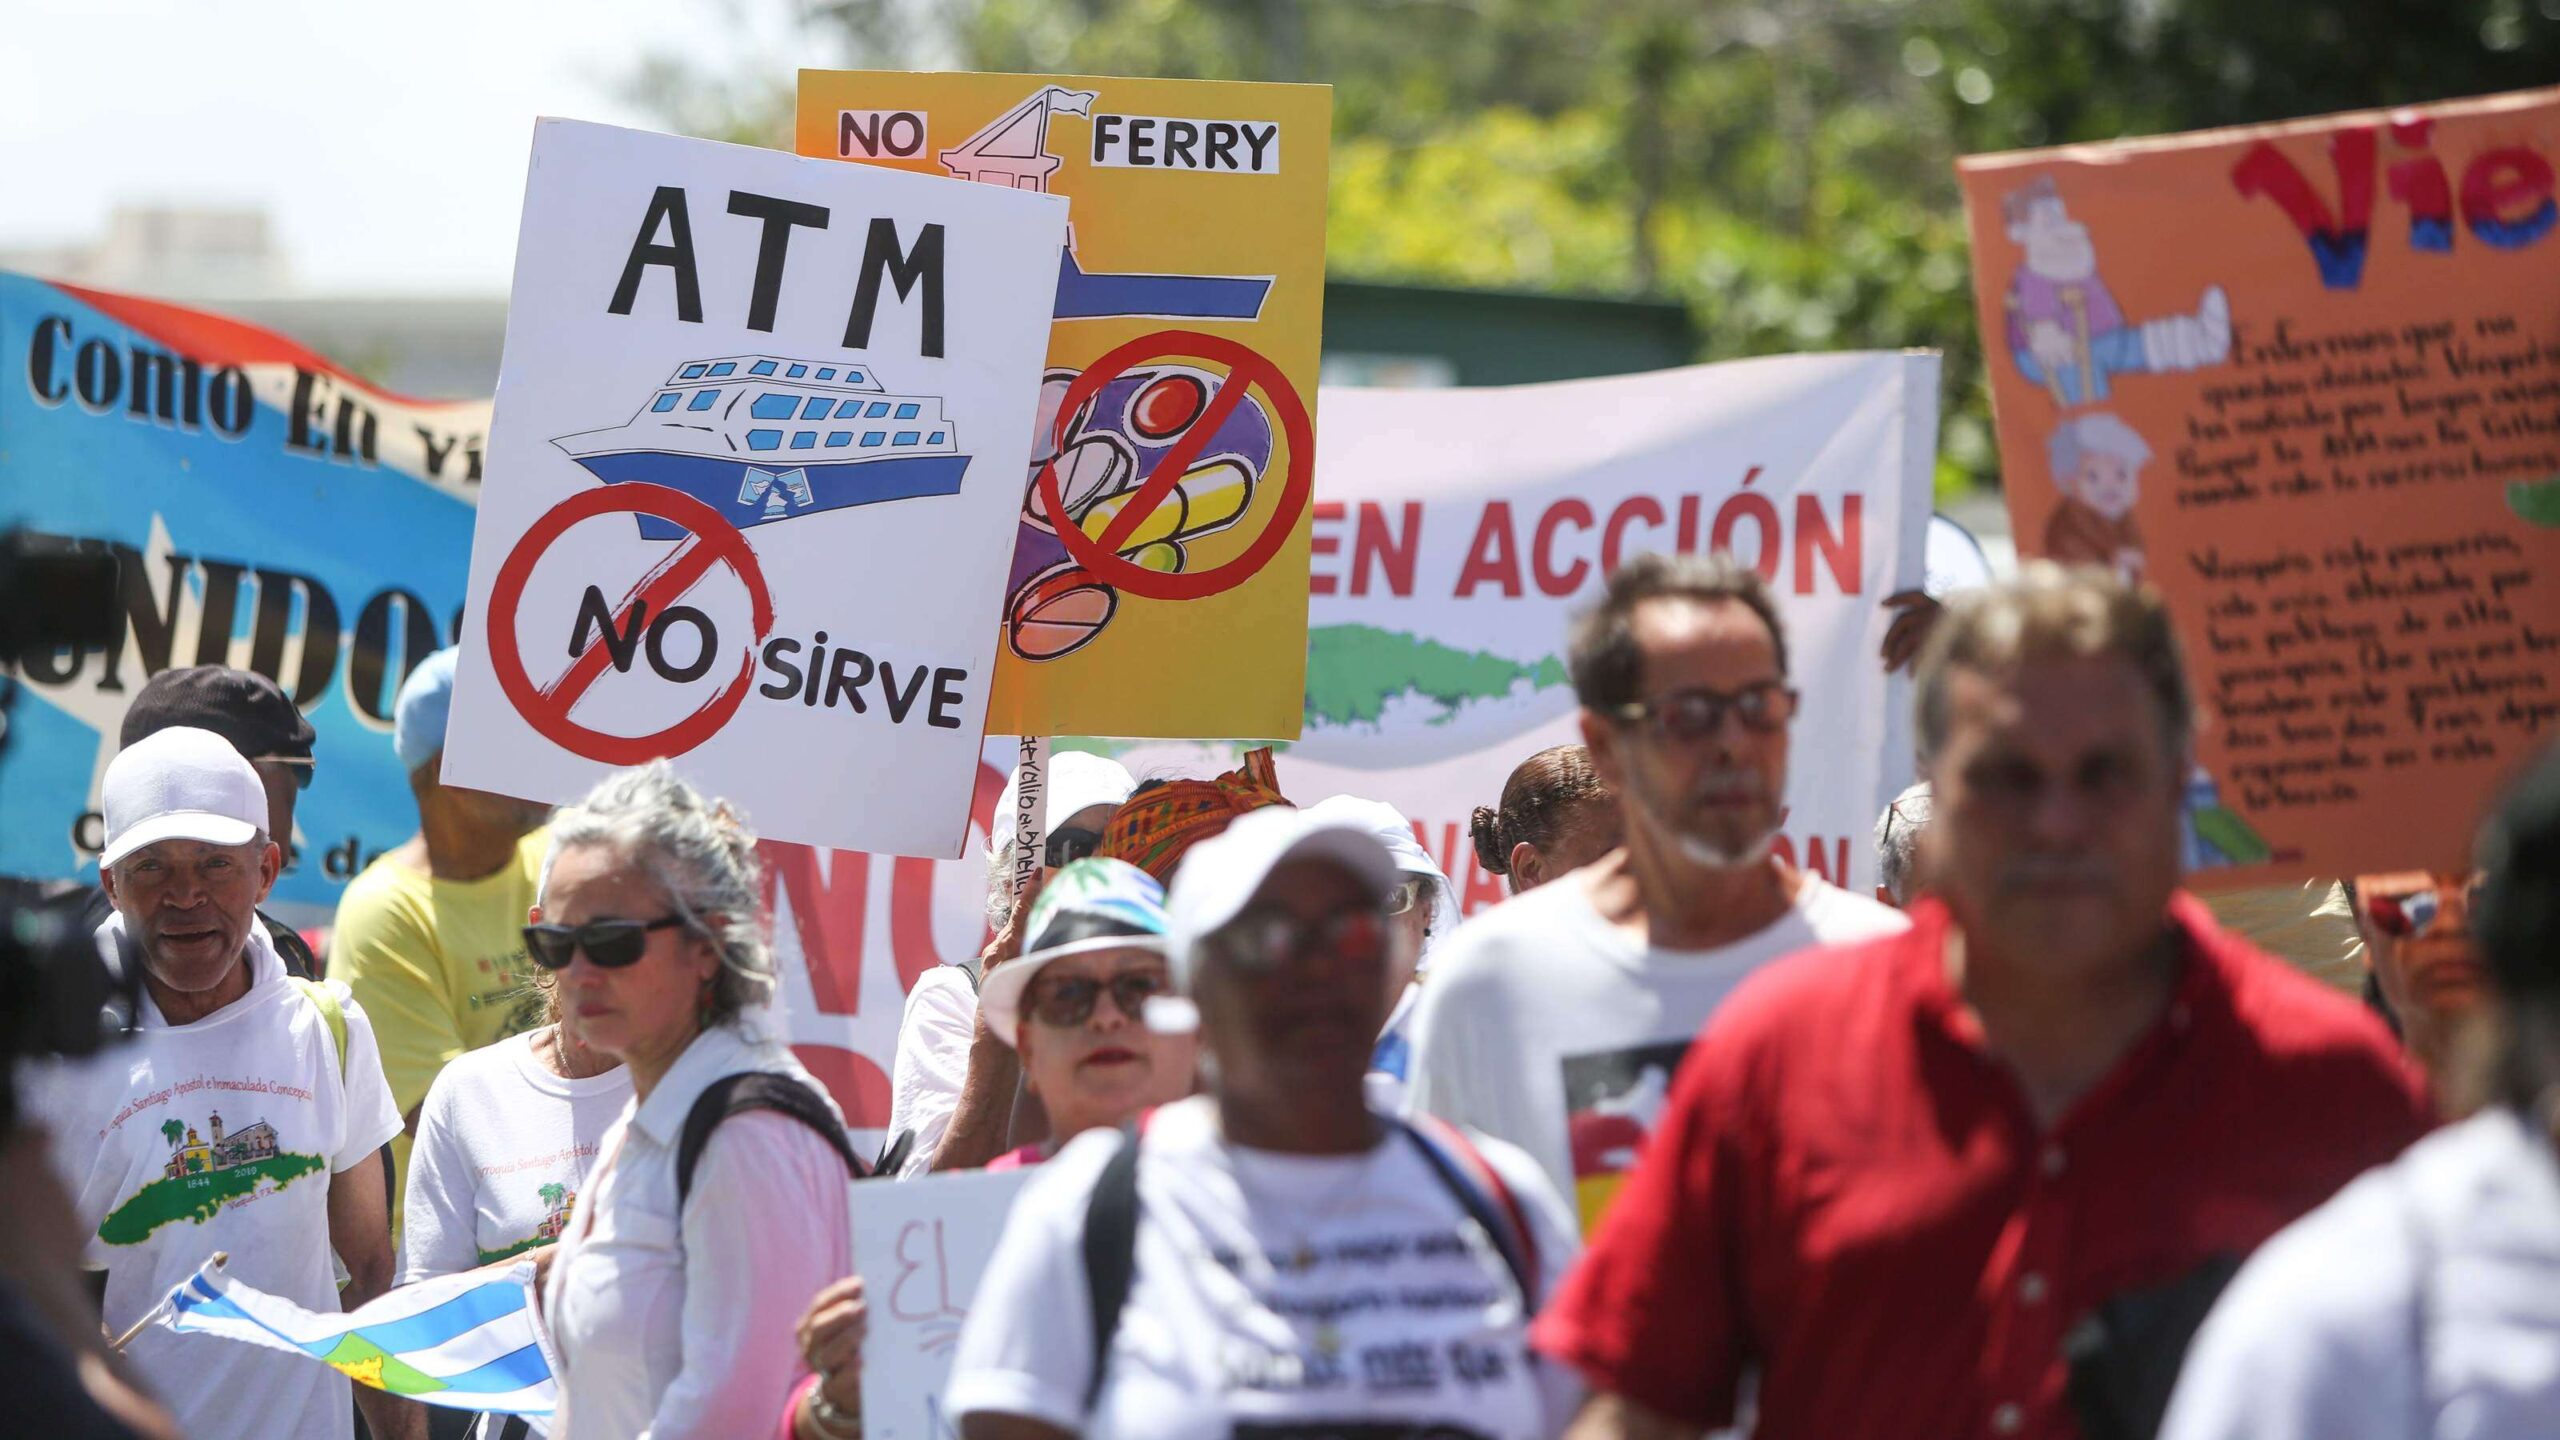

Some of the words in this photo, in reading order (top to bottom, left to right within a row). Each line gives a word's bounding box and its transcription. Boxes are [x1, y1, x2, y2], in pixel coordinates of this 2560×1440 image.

[839, 111, 926, 158] NO
[1093, 114, 1278, 172] FERRY
[2231, 117, 2559, 291] Vie
[607, 185, 945, 359] ATM
[29, 316, 254, 440] Como
[286, 366, 379, 467] En
[1454, 463, 1864, 599] ACCIÓN
[567, 584, 719, 684] NO
[132, 1087, 173, 1114] Santiago
